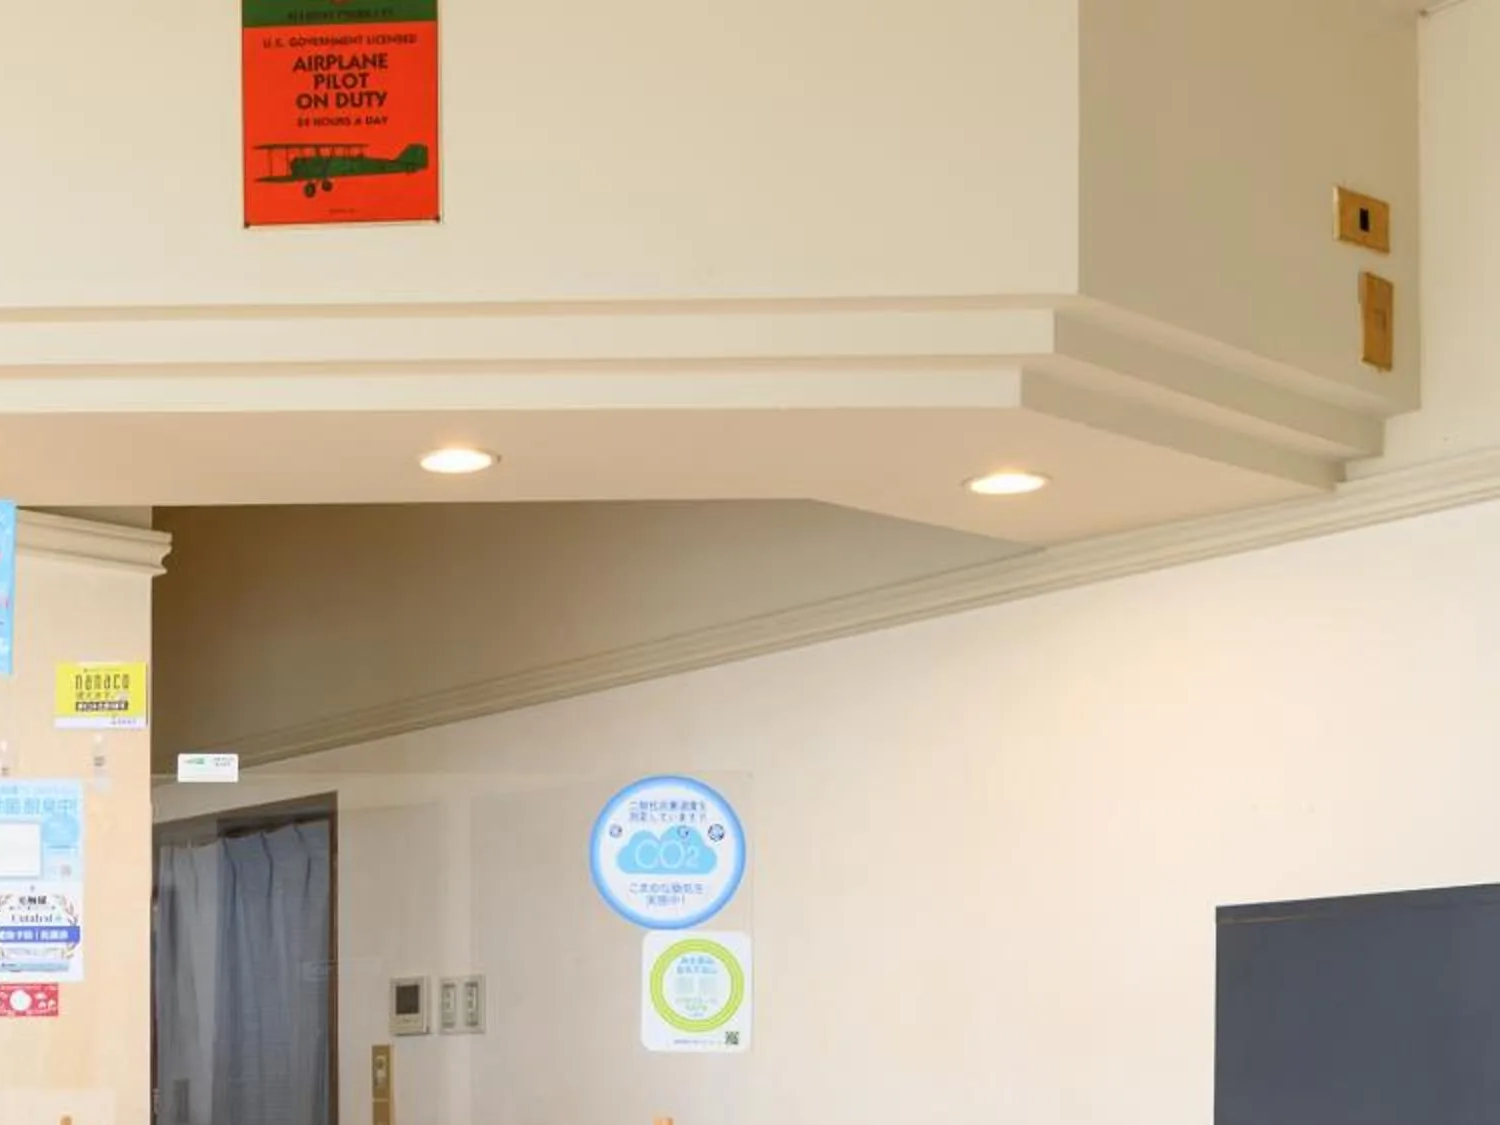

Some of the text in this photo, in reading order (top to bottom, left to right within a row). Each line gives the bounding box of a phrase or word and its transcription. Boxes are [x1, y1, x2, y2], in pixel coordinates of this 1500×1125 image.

[289, 34, 363, 48] GOVERNMENT
[366, 33, 417, 45] LICENSED
[292, 52, 389, 73] AIRPLANE
[313, 72, 370, 90] PILOT
[295, 90, 388, 110] ON DUTY
[74, 673, 131, 690] nanaco
